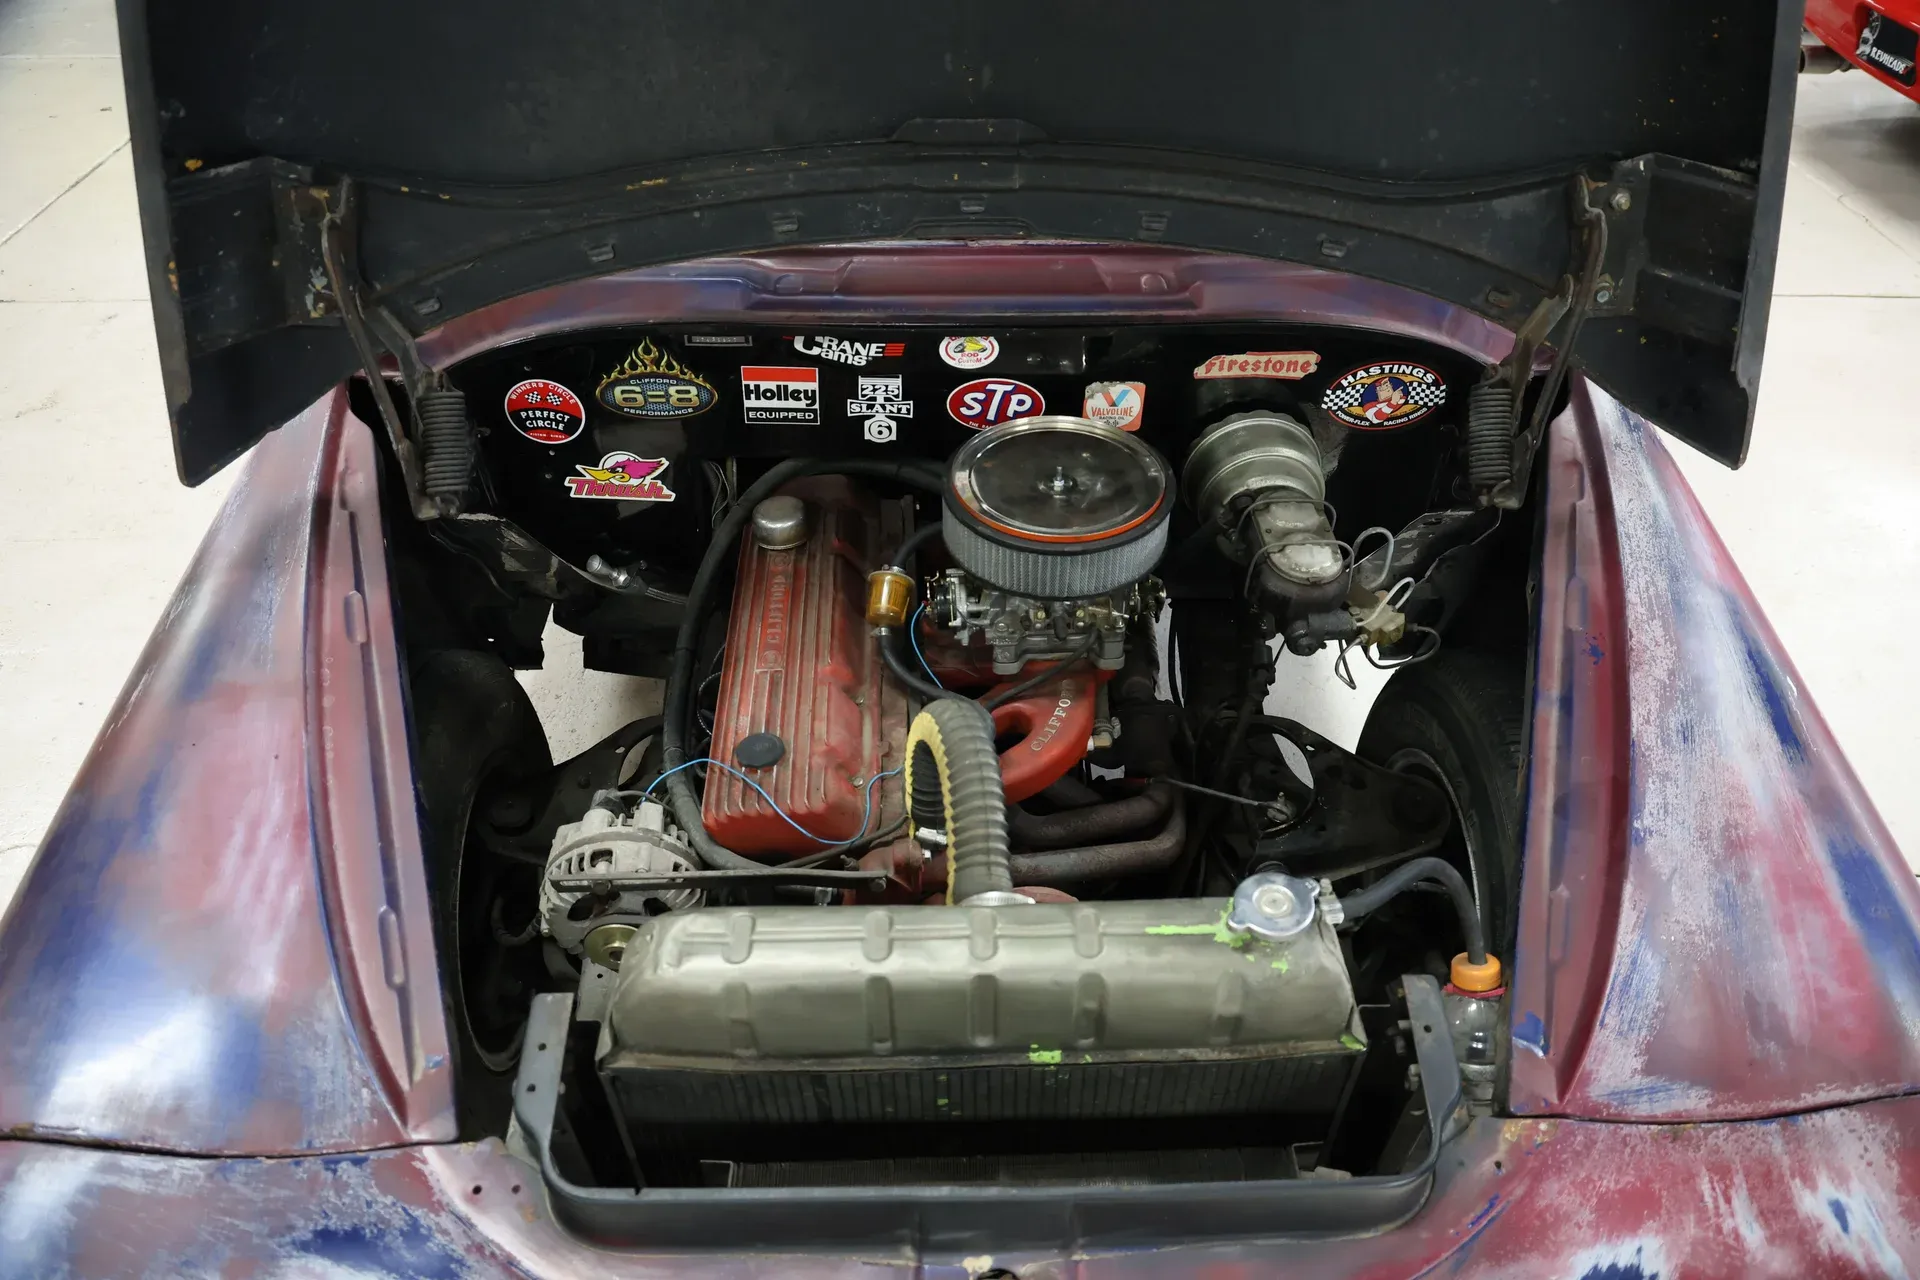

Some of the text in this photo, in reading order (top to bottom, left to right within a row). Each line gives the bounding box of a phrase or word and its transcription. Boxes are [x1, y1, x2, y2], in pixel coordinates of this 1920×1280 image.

[1870, 46, 1906, 74] REVHEADS
[1204, 356, 1312, 374] Firestone
[1340, 364, 1436, 387] HASTINGS
[510, 382, 576, 405] WINNERS CIRCLE
[743, 384, 817, 407] Holley
[861, 384, 899, 396] 225
[623, 407, 694, 416] PERFORMANCE
[850, 403, 911, 414] SLANT
[960, 383, 1033, 421] STP
[1091, 406, 1134, 417] VALVOLINE
[520, 410, 570, 422] PERFECT
[749, 411, 814, 420] EQUIPPED
[1383, 416, 1408, 426] RACING
[1409, 407, 1428, 420] RINGS
[526, 420, 565, 431] CIRCLE
[875, 420, 890, 439] 6
[568, 478, 673, 499] Thrush
[766, 574, 788, 644] CLIFFORD
